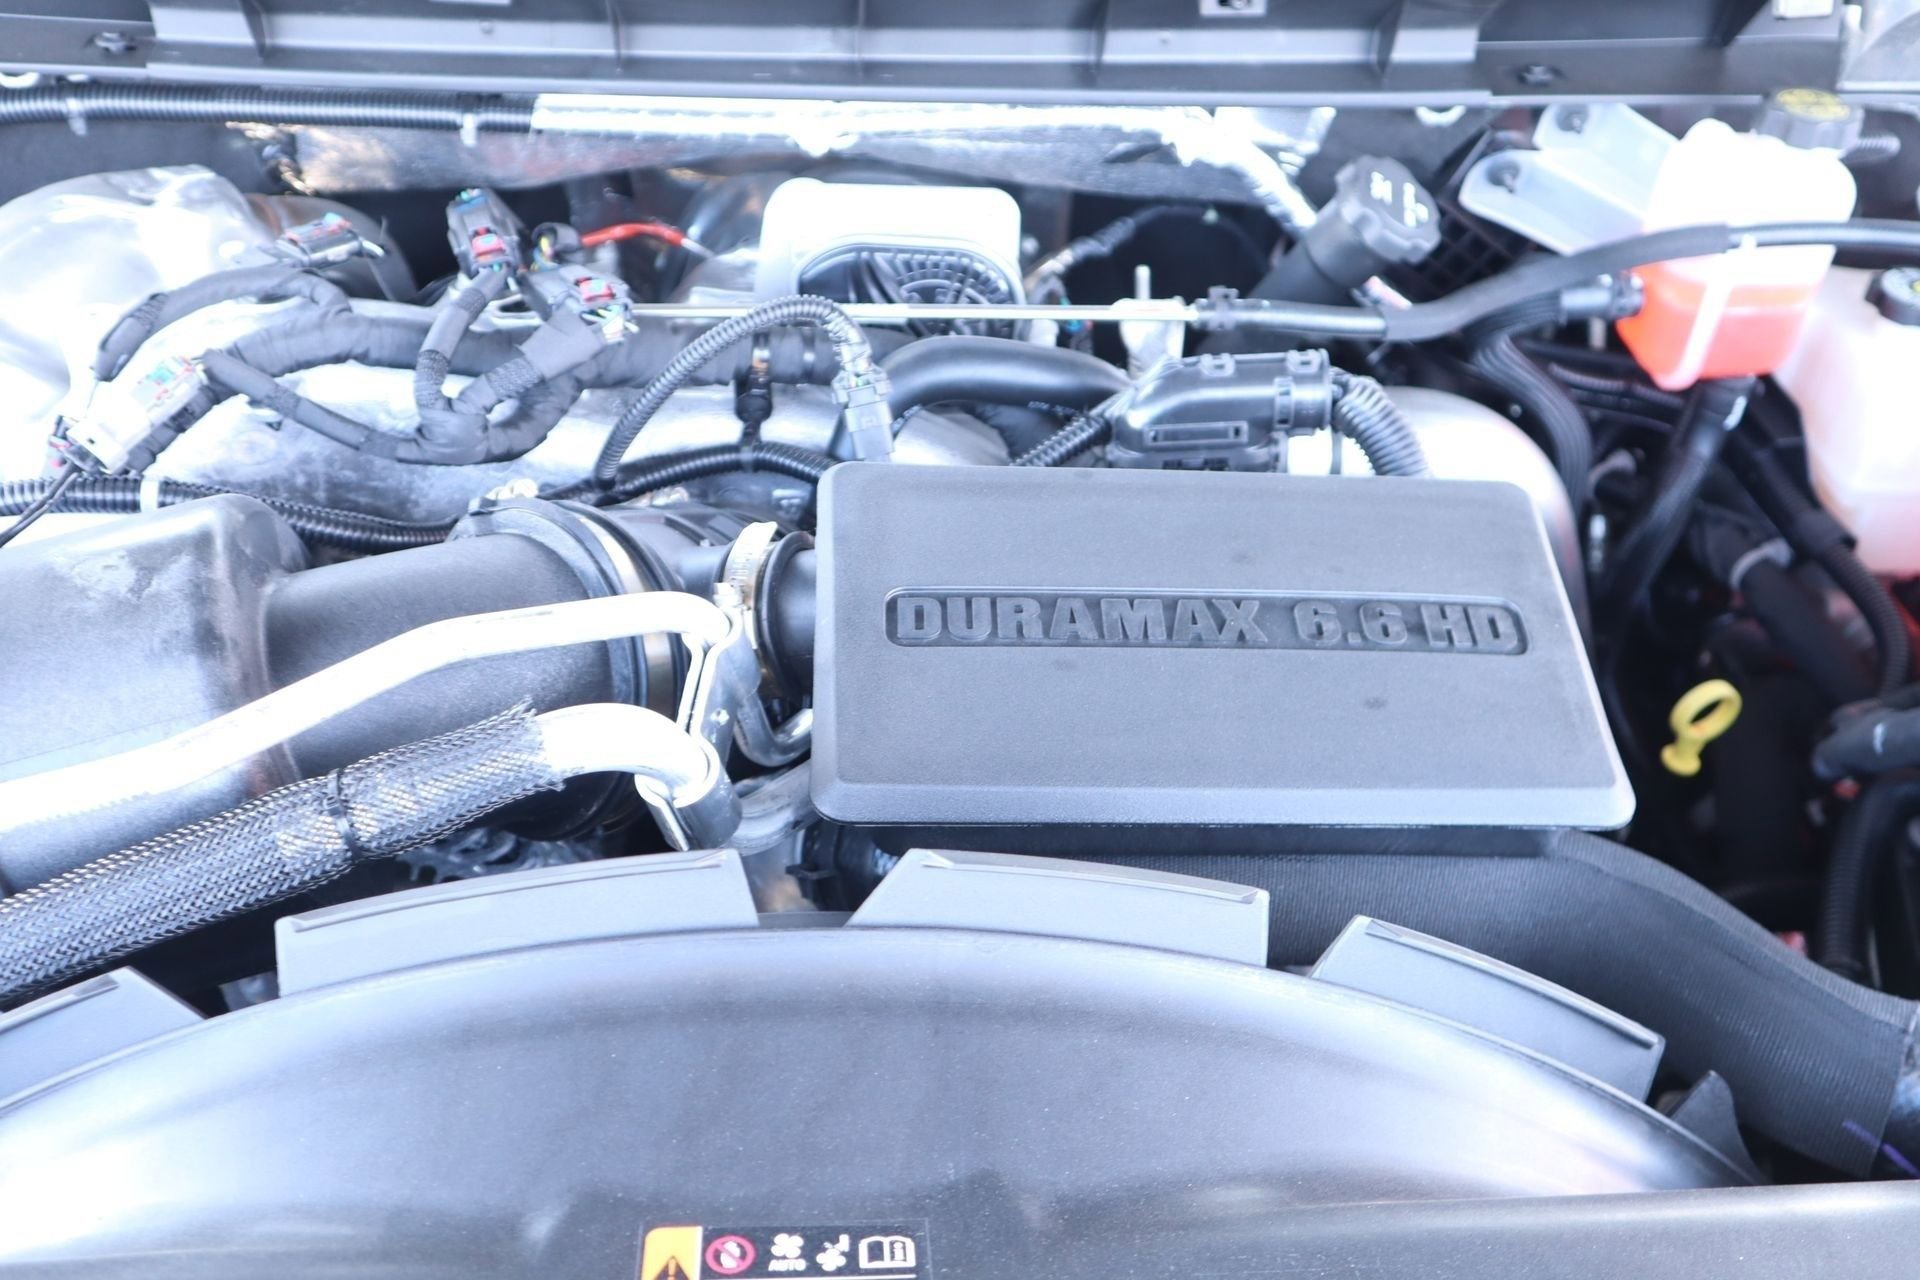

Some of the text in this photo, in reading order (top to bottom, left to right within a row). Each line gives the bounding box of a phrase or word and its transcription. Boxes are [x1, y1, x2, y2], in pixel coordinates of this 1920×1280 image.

[896, 596, 1519, 651] DURAMAX 6.6 HD
[768, 1258, 807, 1272] AUTO
